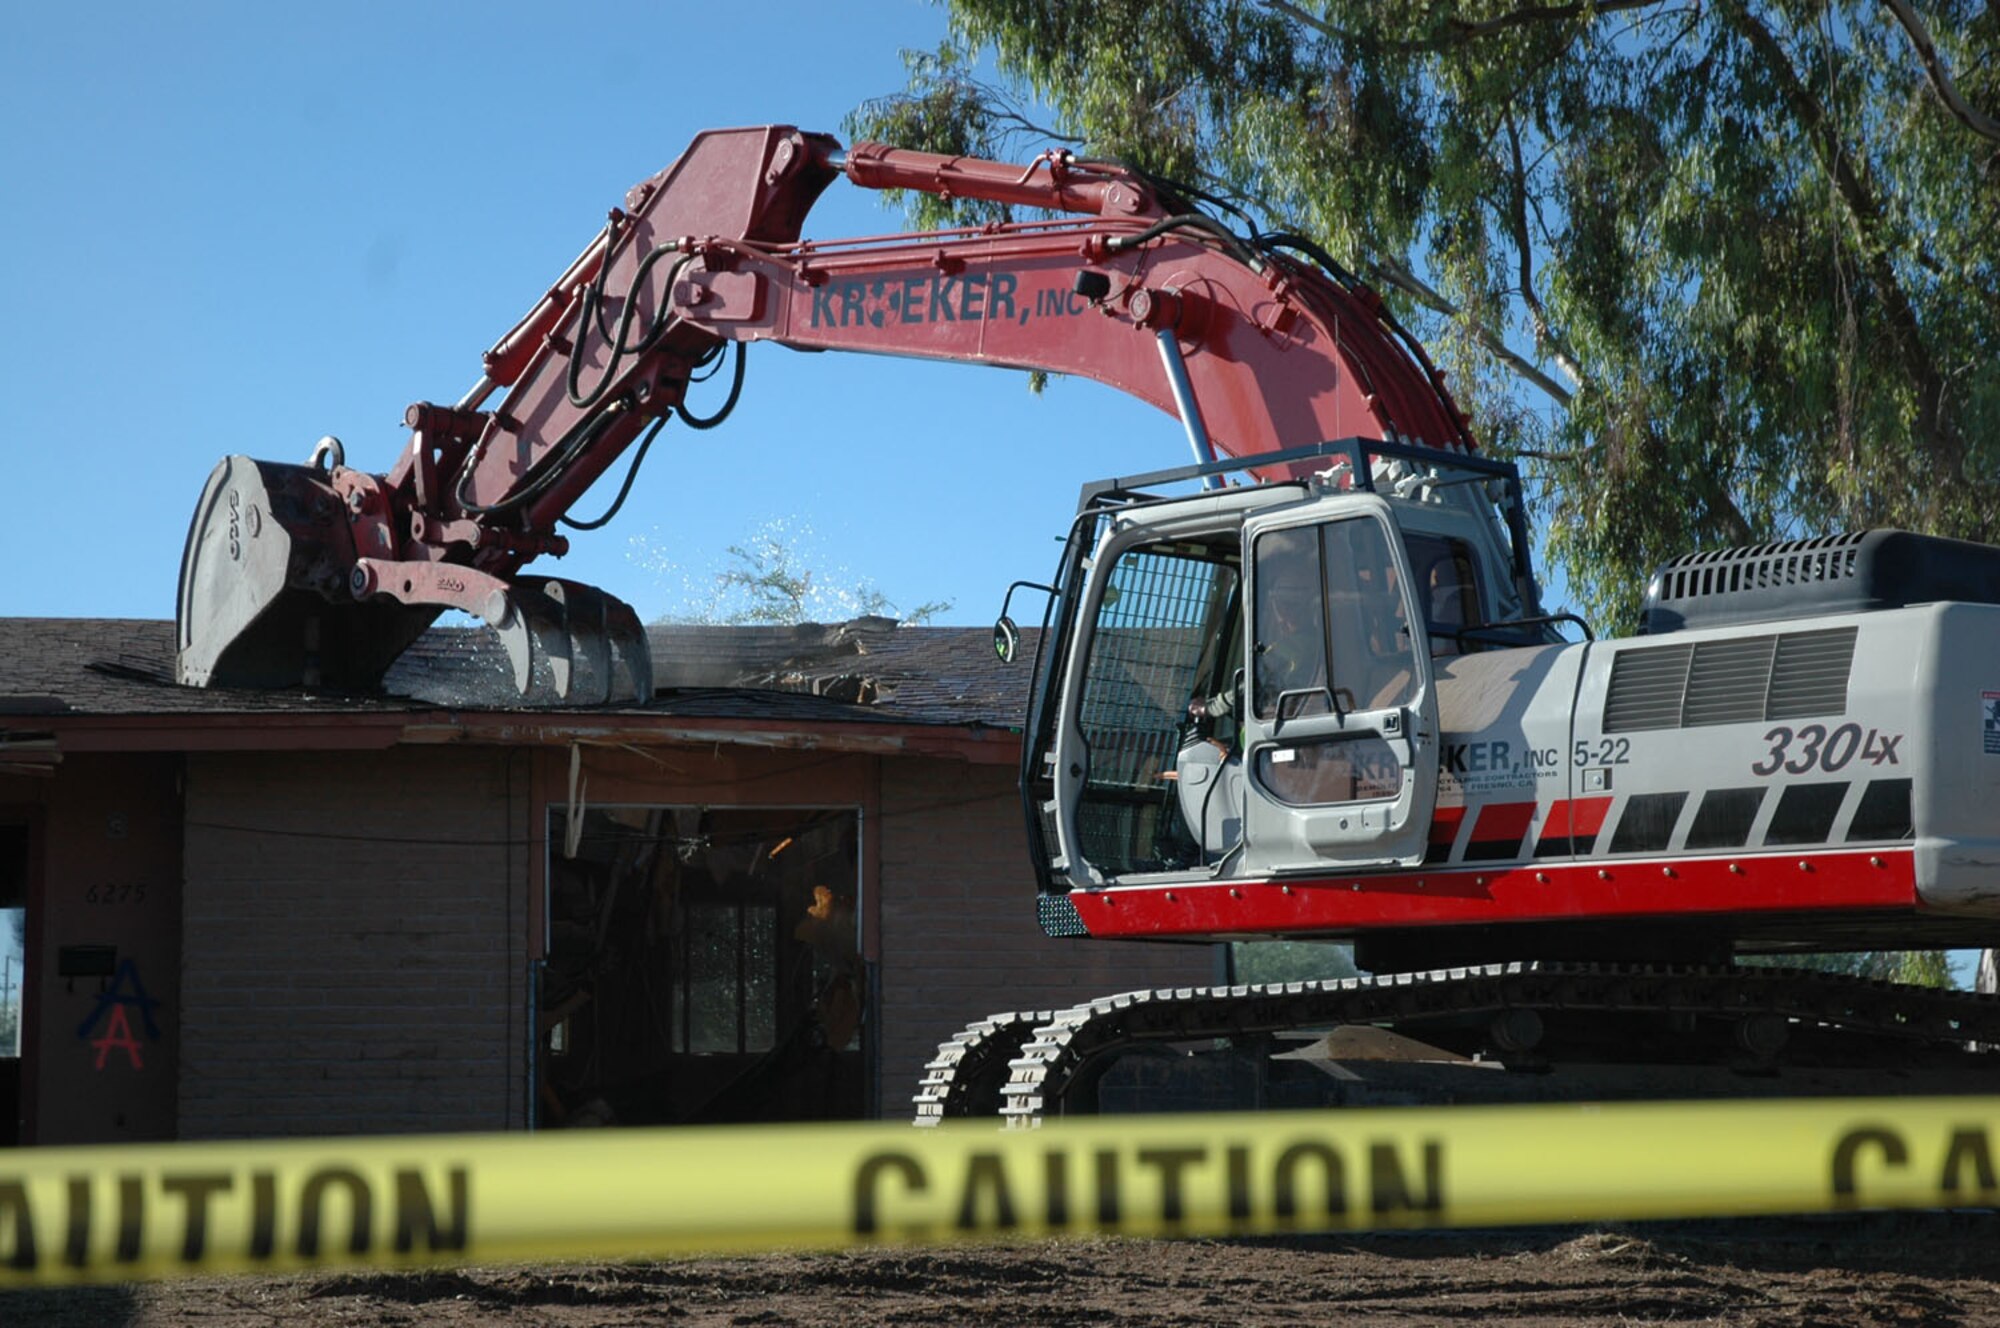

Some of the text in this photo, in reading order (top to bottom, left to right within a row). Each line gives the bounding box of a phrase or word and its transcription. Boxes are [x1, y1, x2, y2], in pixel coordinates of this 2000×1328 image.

[1523, 748, 1558, 769] INC
[1573, 738, 1631, 767] 5-22
[86, 882, 148, 903] 6275
[78, 959, 160, 1040] A
[92, 1003, 143, 1070] A
[851, 1138, 1442, 1235] CAUTION
